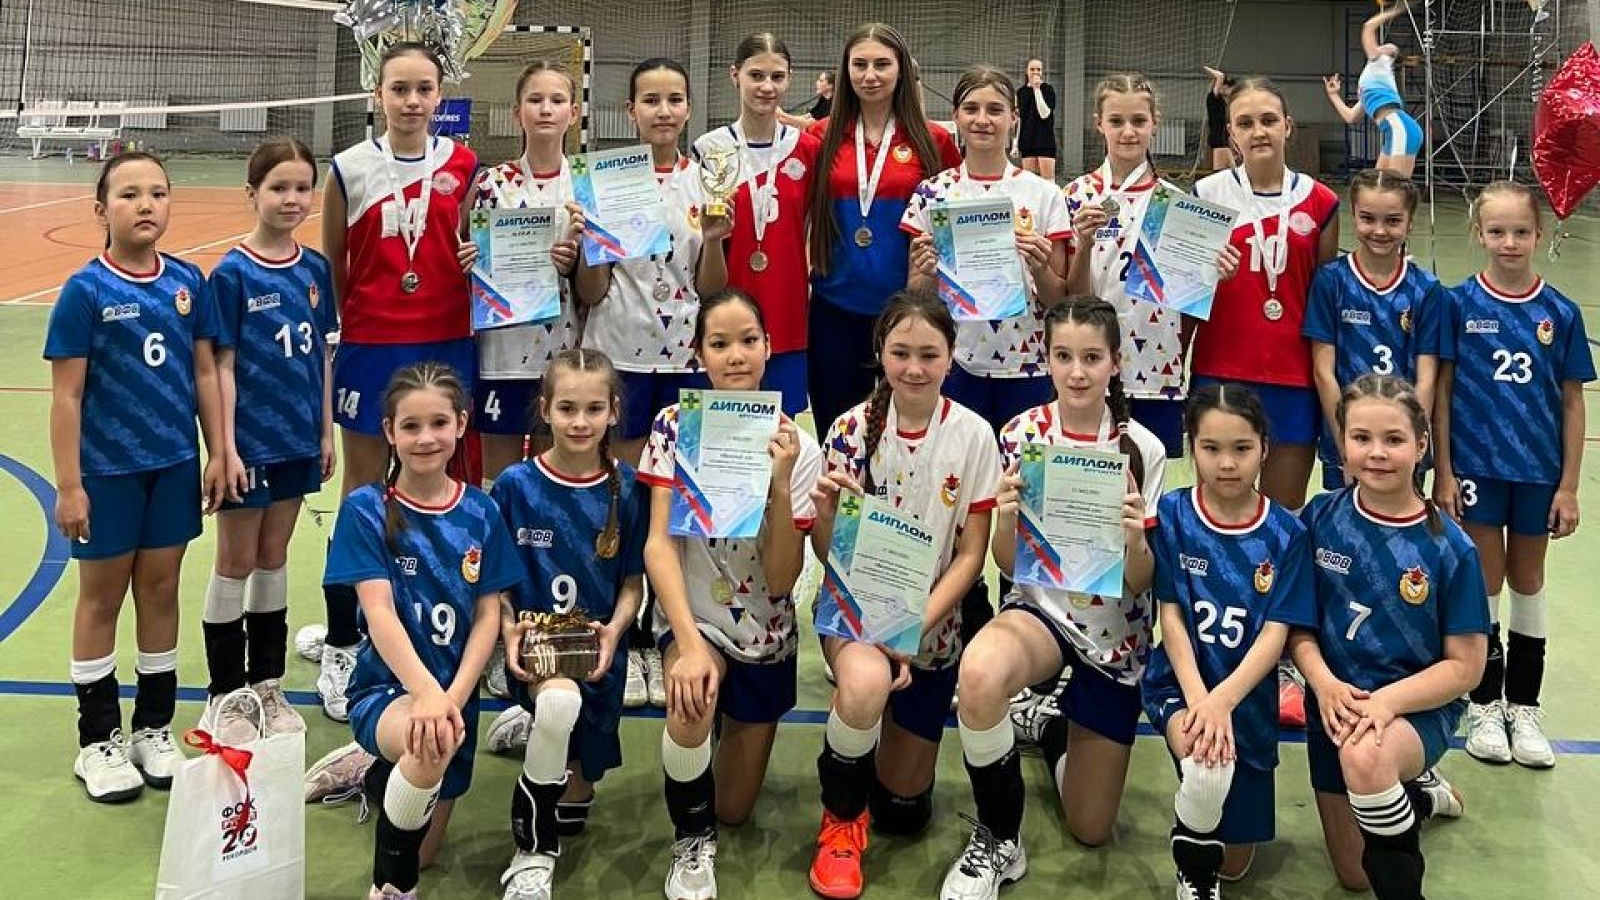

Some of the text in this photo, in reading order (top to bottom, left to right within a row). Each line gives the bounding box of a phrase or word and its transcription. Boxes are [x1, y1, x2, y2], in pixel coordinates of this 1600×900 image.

[594, 153, 648, 171] ДИПЛОМ
[495, 215, 551, 227] ДИПЛОМ
[956, 211, 1011, 225] ДИПЛОМ
[1174, 200, 1232, 224] ДИПЛОМ
[1245, 235, 1288, 273] 10
[144, 332, 166, 367] 6
[275, 322, 312, 358] 13
[1373, 344, 1394, 375] 3
[1493, 349, 1532, 383] 23
[337, 388, 361, 419] 14
[484, 390, 501, 421] 4
[709, 400, 776, 415] ДИПЛОМ
[1052, 455, 1123, 470] ДИПЛОМ
[868, 510, 933, 544] ДИПЛОМ
[551, 574, 577, 614] 9
[1194, 600, 1247, 648] 25
[1346, 601, 1372, 640] 7
